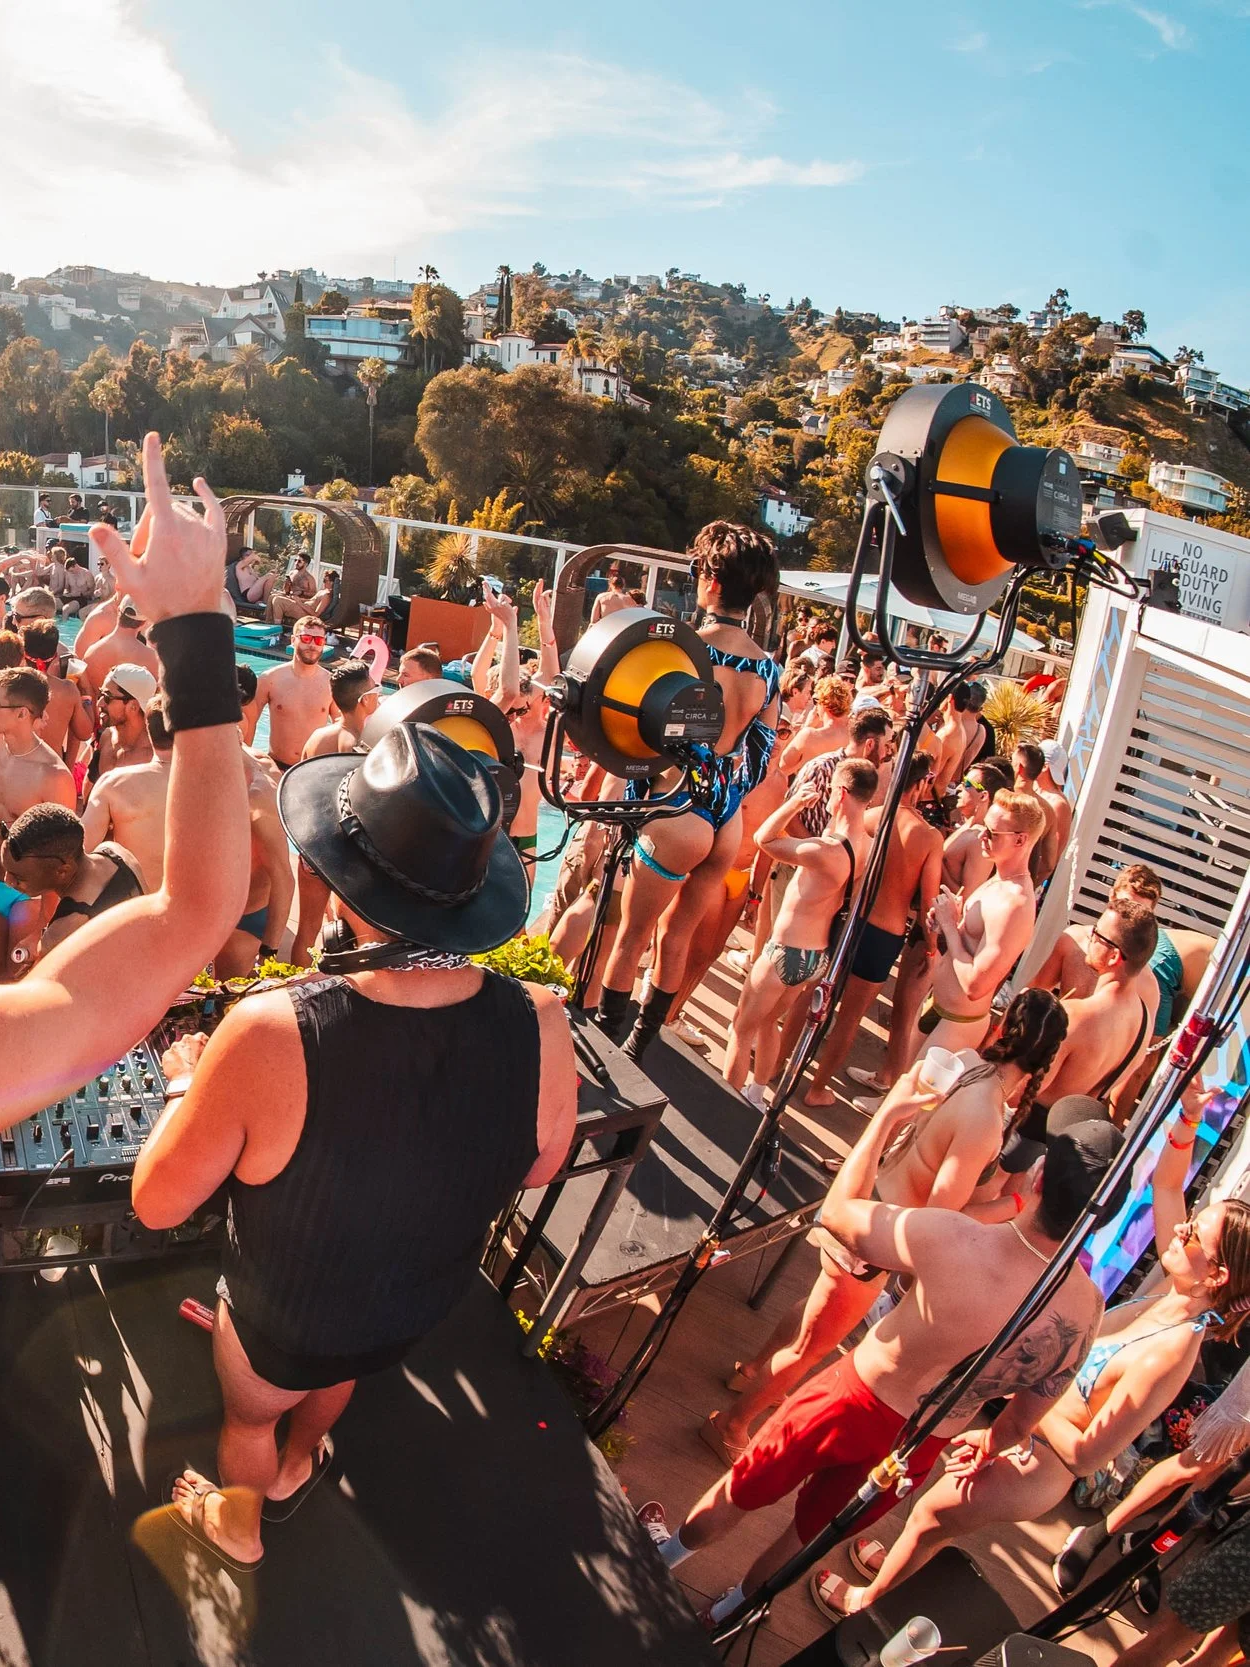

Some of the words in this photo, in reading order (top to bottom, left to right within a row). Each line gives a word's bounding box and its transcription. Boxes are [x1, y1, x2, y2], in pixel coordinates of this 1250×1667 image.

[976, 393, 991, 411] ETS
[1182, 541, 1203, 560] NO
[1151, 548, 1229, 583] LIFEGUARD
[1181, 573, 1219, 596] DUTY
[1181, 590, 1222, 614] IVING
[655, 623, 676, 634] ETS
[453, 699, 475, 710] ETS
